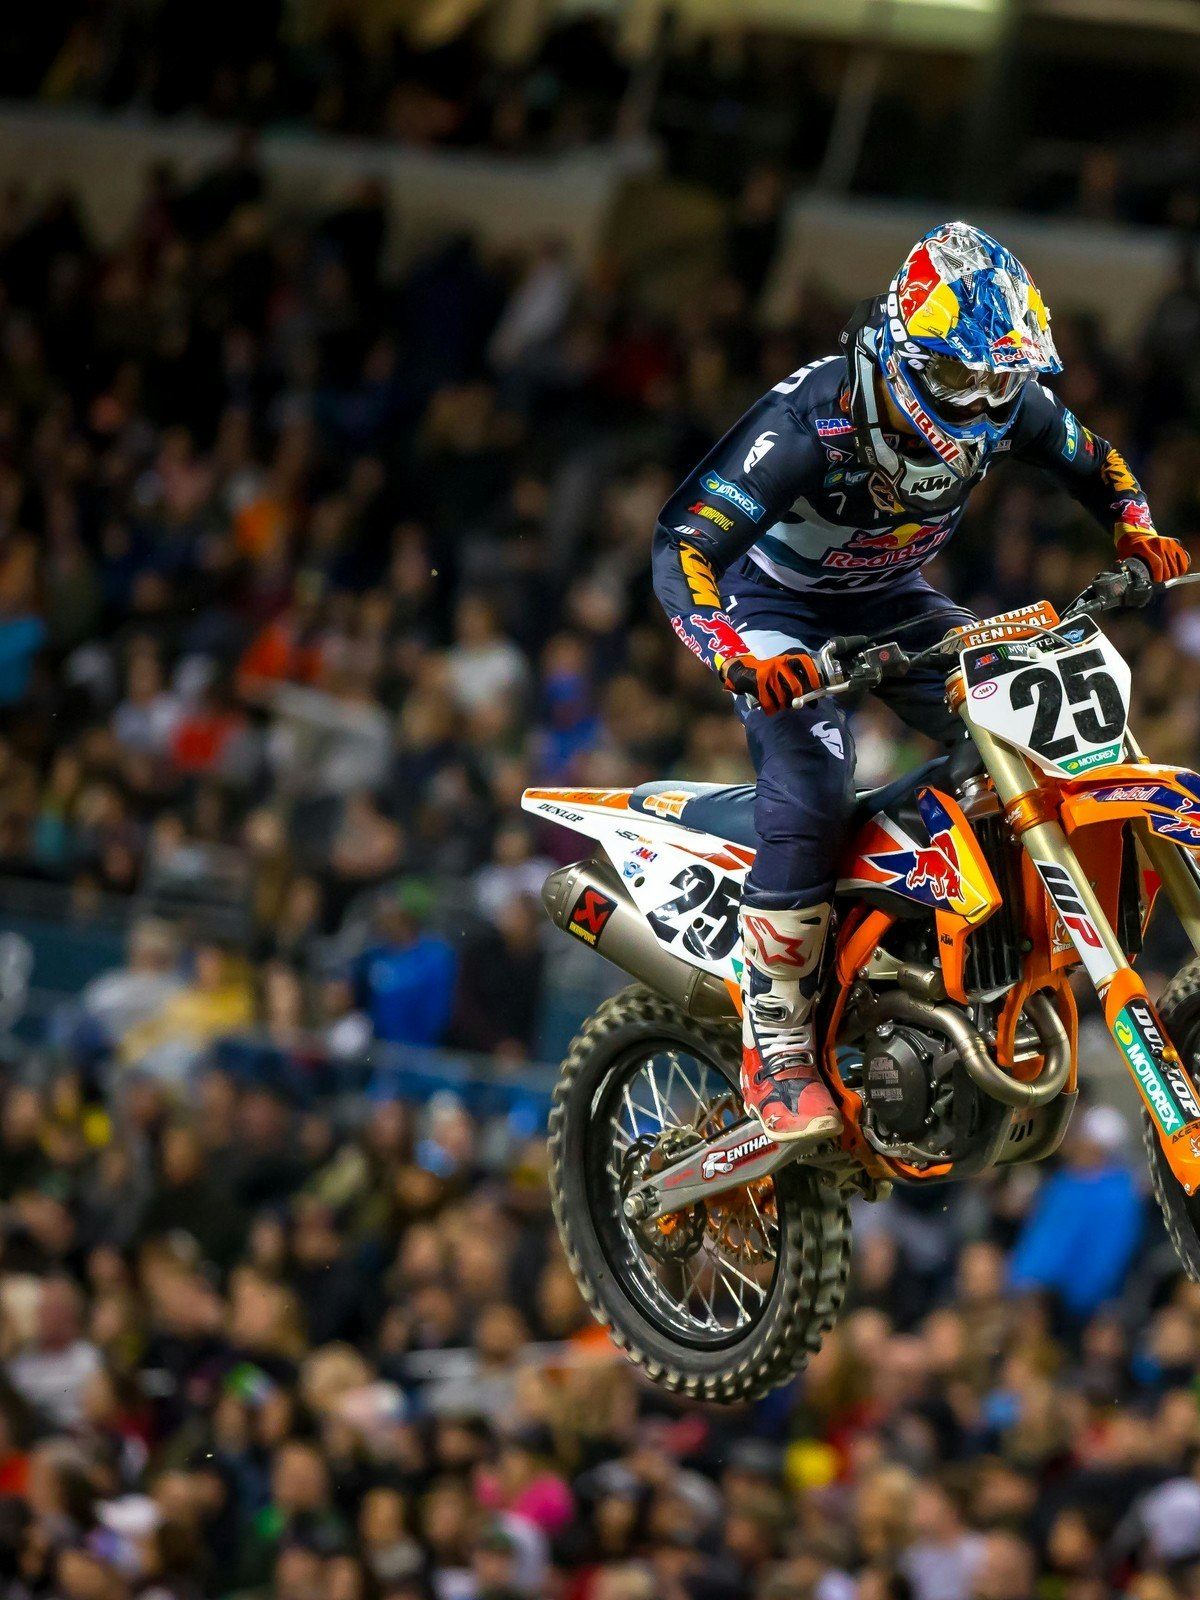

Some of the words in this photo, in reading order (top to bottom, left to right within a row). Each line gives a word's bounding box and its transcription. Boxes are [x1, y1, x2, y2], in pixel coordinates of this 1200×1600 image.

[951, 336, 975, 360] Airoh
[992, 349, 1025, 366] Red
[815, 418, 853, 430] PAR
[914, 411, 961, 463] Bull
[909, 473, 952, 496] KTM
[822, 550, 891, 569] Red
[679, 540, 722, 609] KTM
[968, 613, 1053, 647] RENTHAL
[1009, 648, 1127, 761] 25
[1078, 749, 1117, 767] MOTOREX
[537, 803, 585, 823] DUNLOP
[645, 864, 742, 961] 25
[1037, 864, 1104, 949] WP
[1126, 1043, 1180, 1132] MOTOREX
